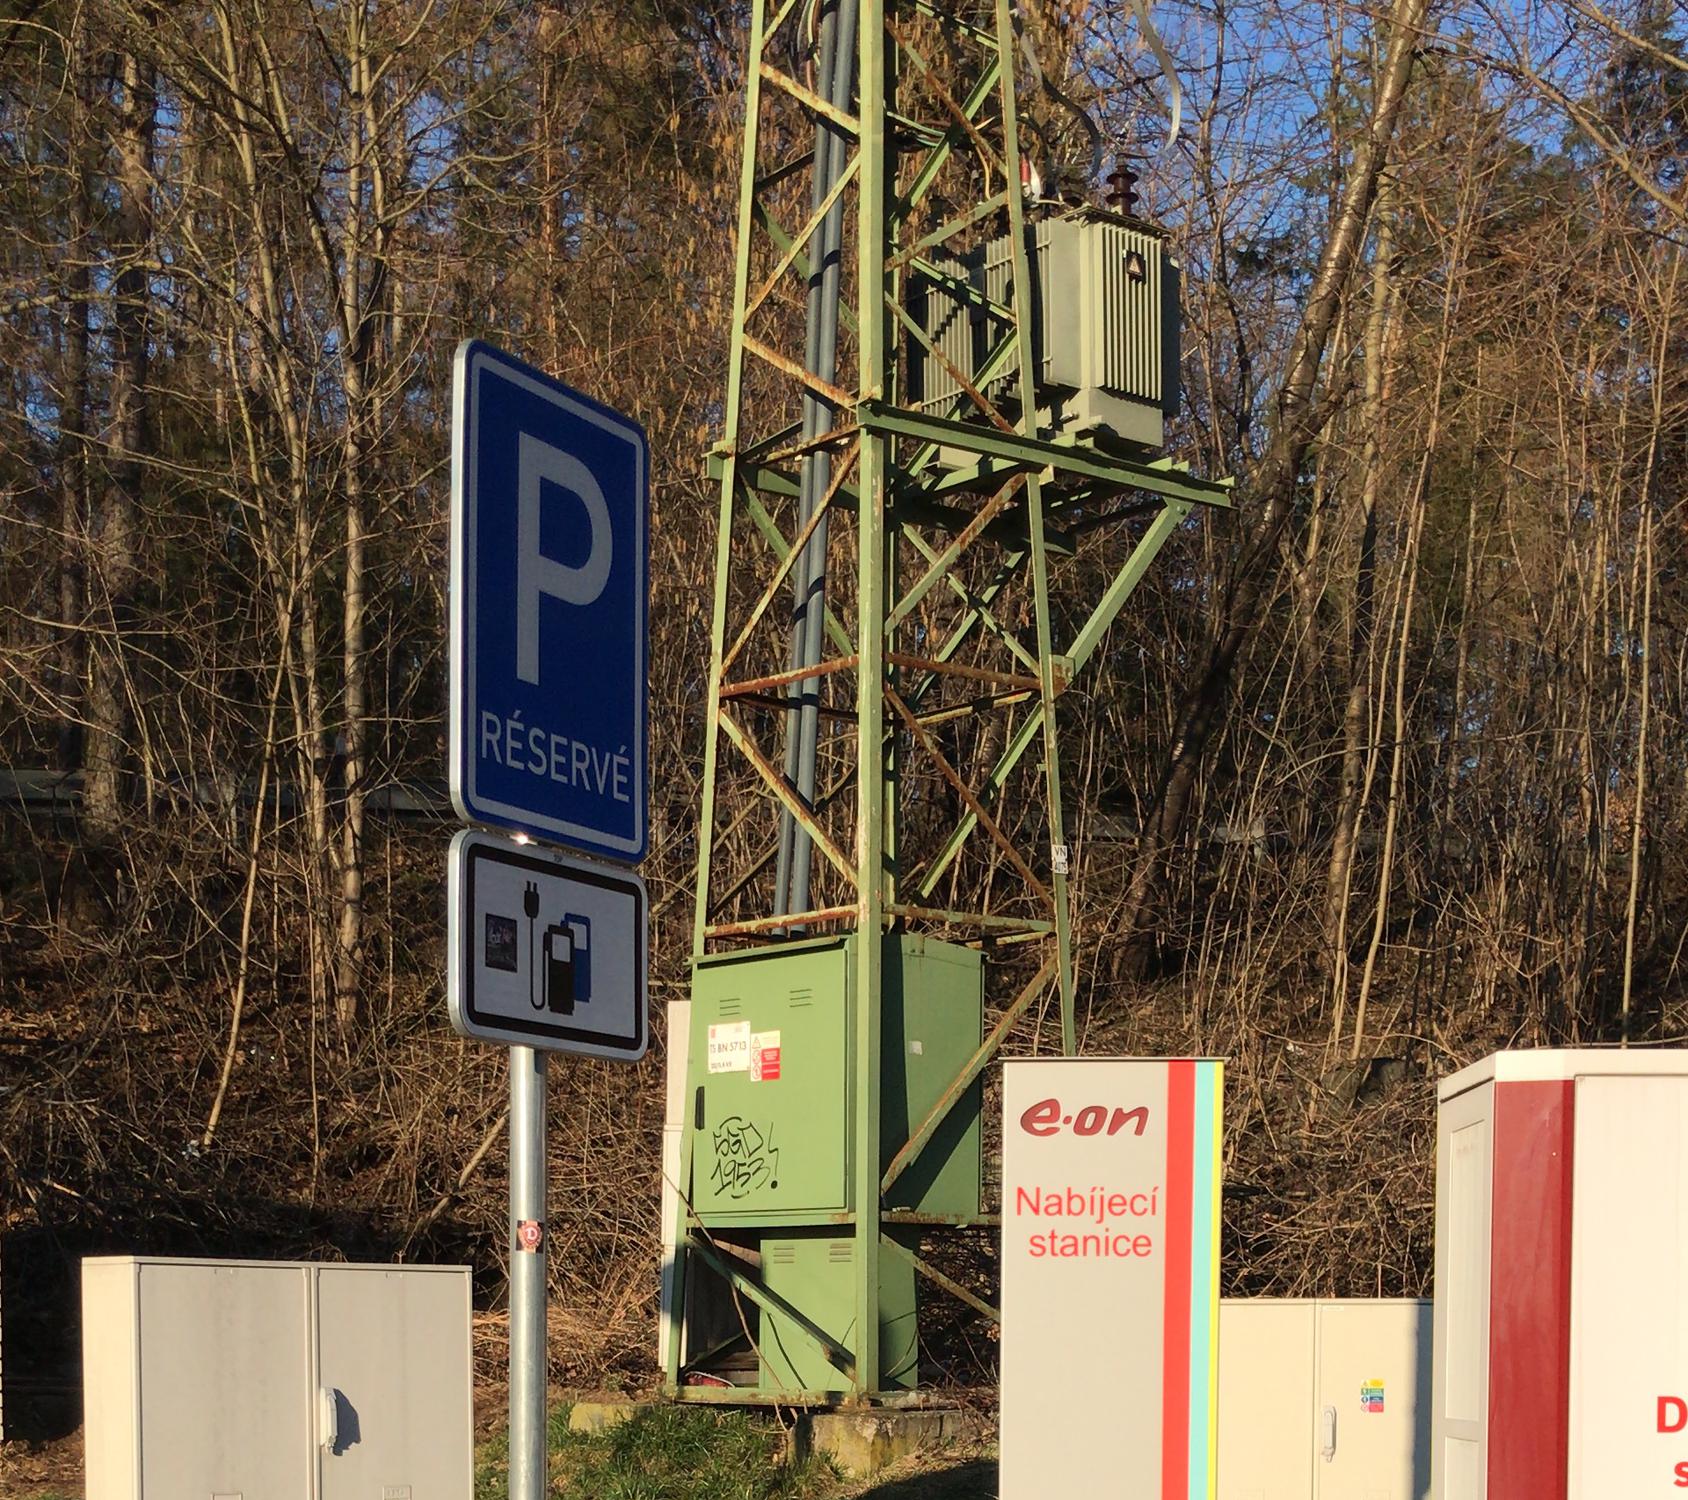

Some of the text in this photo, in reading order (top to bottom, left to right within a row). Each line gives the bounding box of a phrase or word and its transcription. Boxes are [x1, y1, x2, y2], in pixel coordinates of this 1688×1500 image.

[515, 430, 614, 687] P
[480, 707, 631, 804] RÉSERVÉ
[729, 1040, 747, 1052] 5713
[1016, 1185, 1159, 1224] Nabíjecí
[1028, 1228, 1153, 1258] stanice
